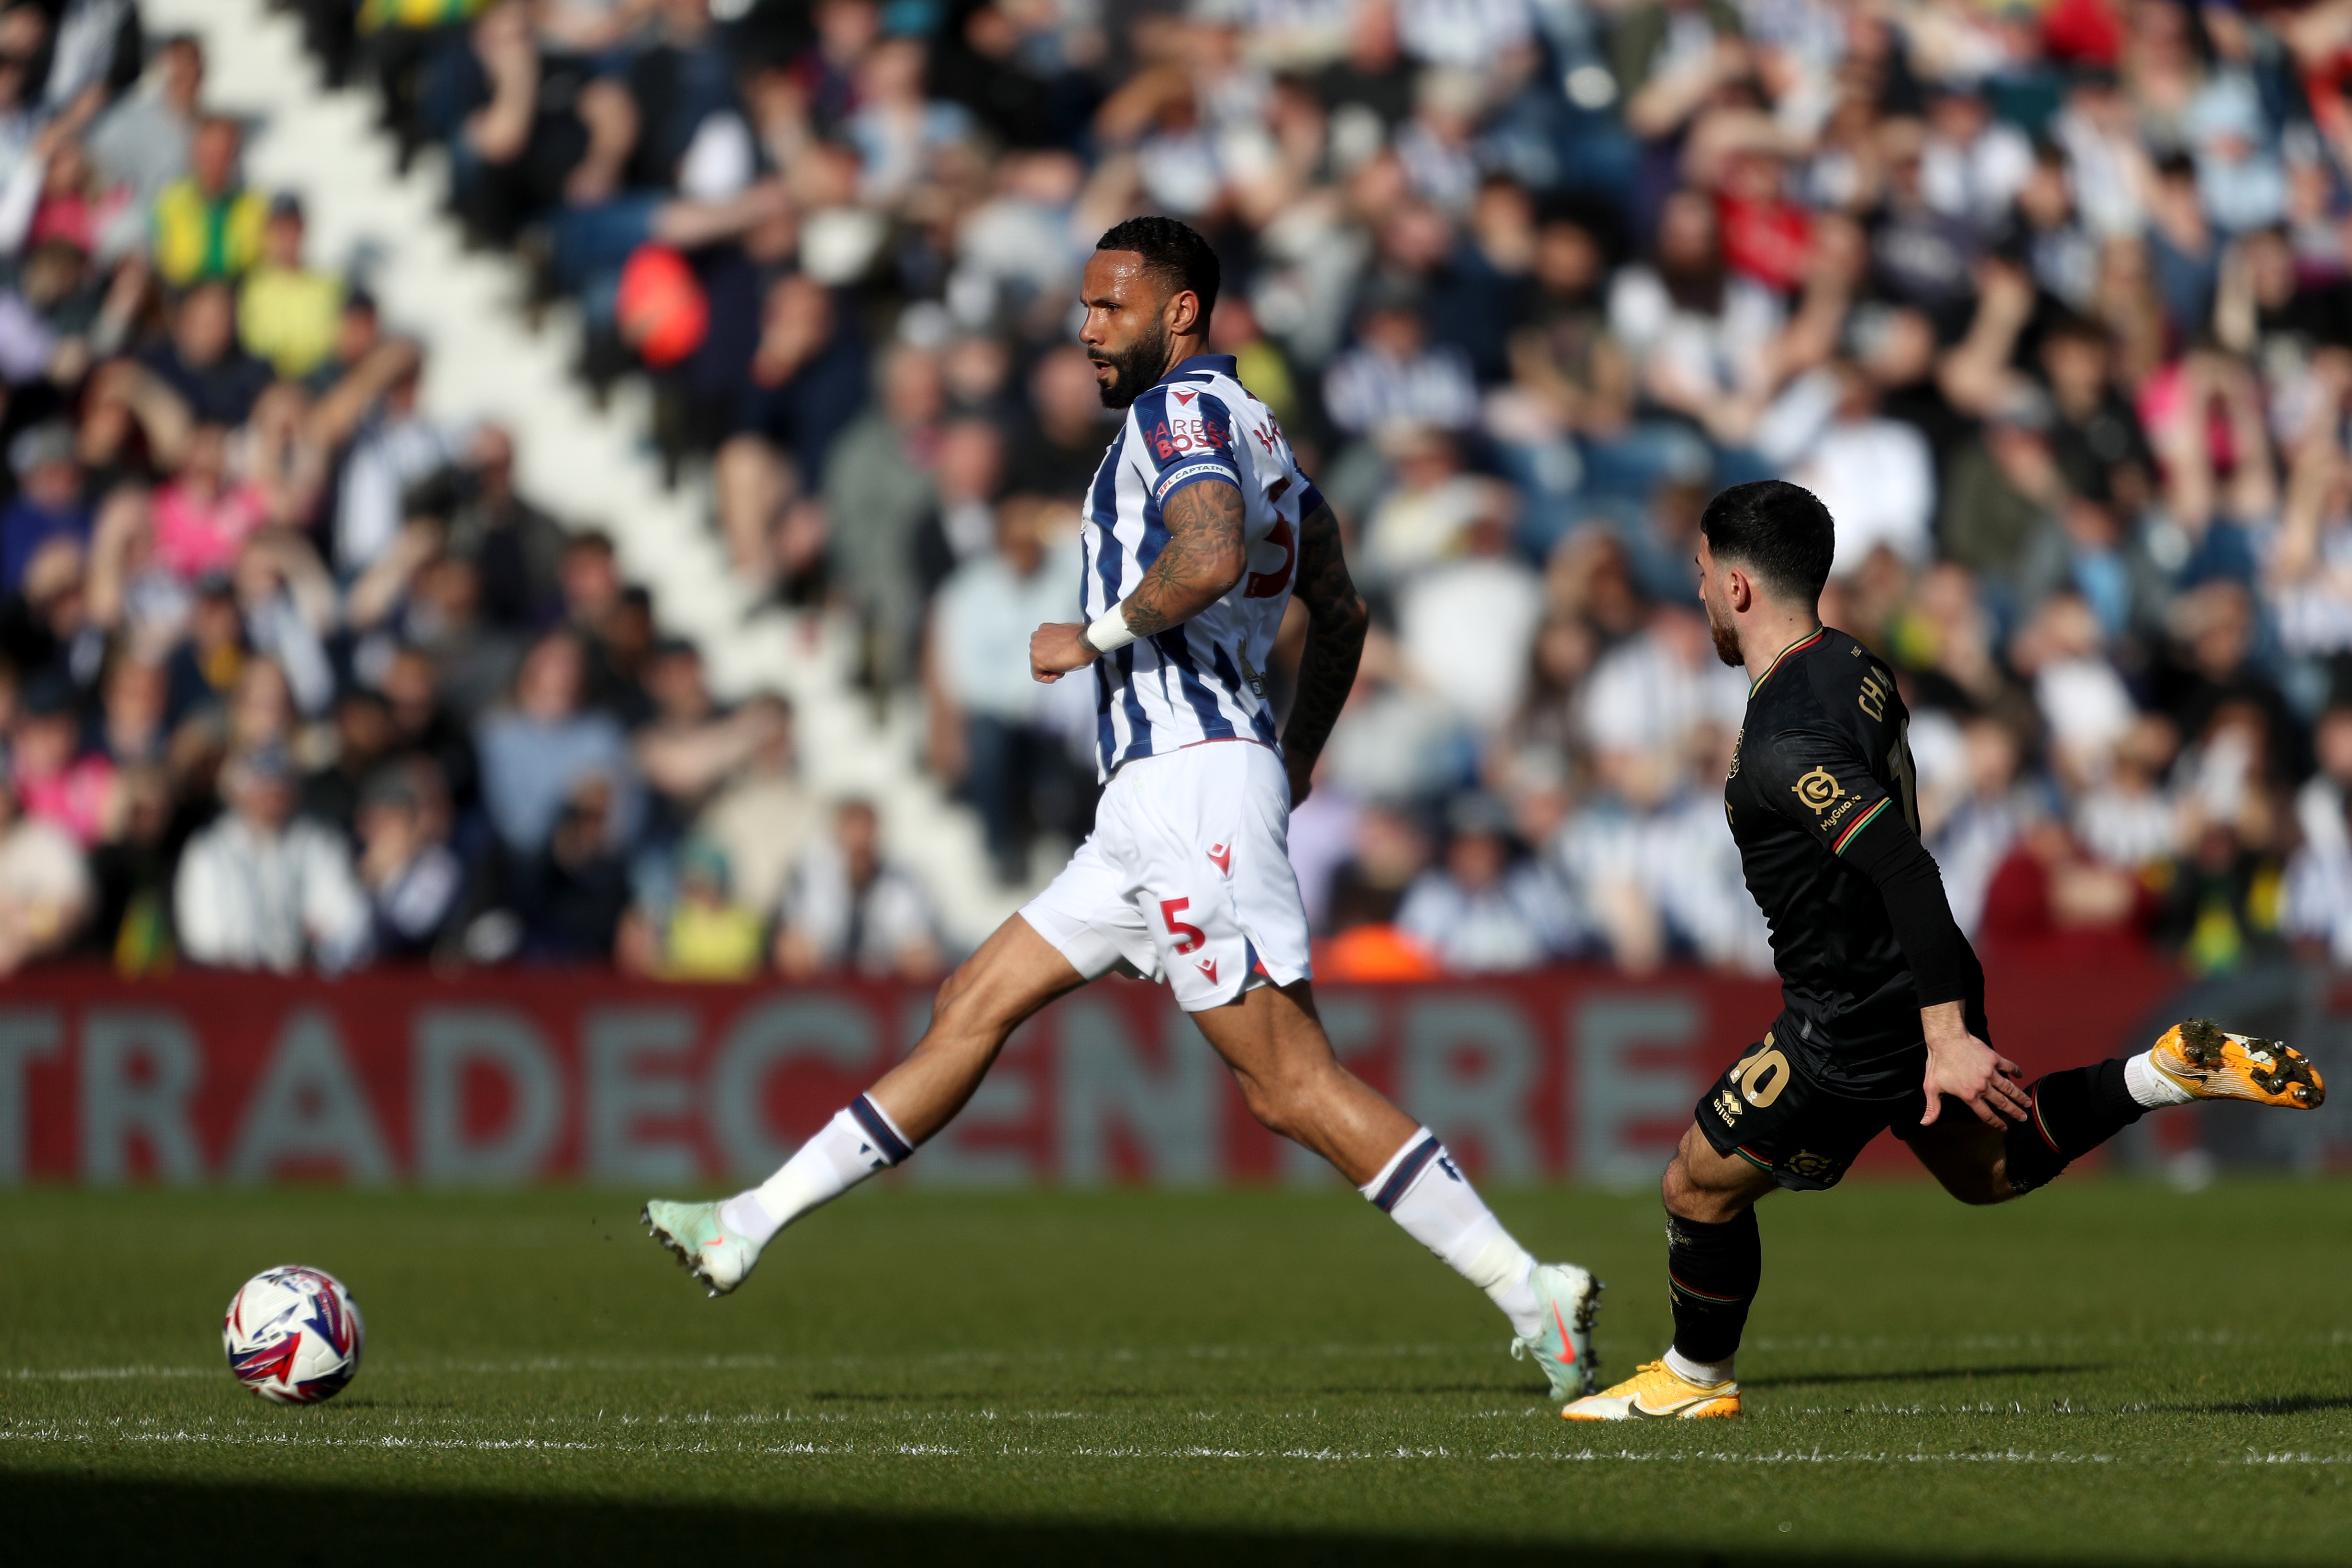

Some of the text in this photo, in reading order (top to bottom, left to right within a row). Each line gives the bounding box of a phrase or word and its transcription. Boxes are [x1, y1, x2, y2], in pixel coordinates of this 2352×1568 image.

[1156, 434, 1223, 459] BOSS
[1159, 465, 1223, 495] EFL CAPTAIN
[1159, 896, 1205, 956] 5
[0, 997, 1705, 1189] TRADECENRE
